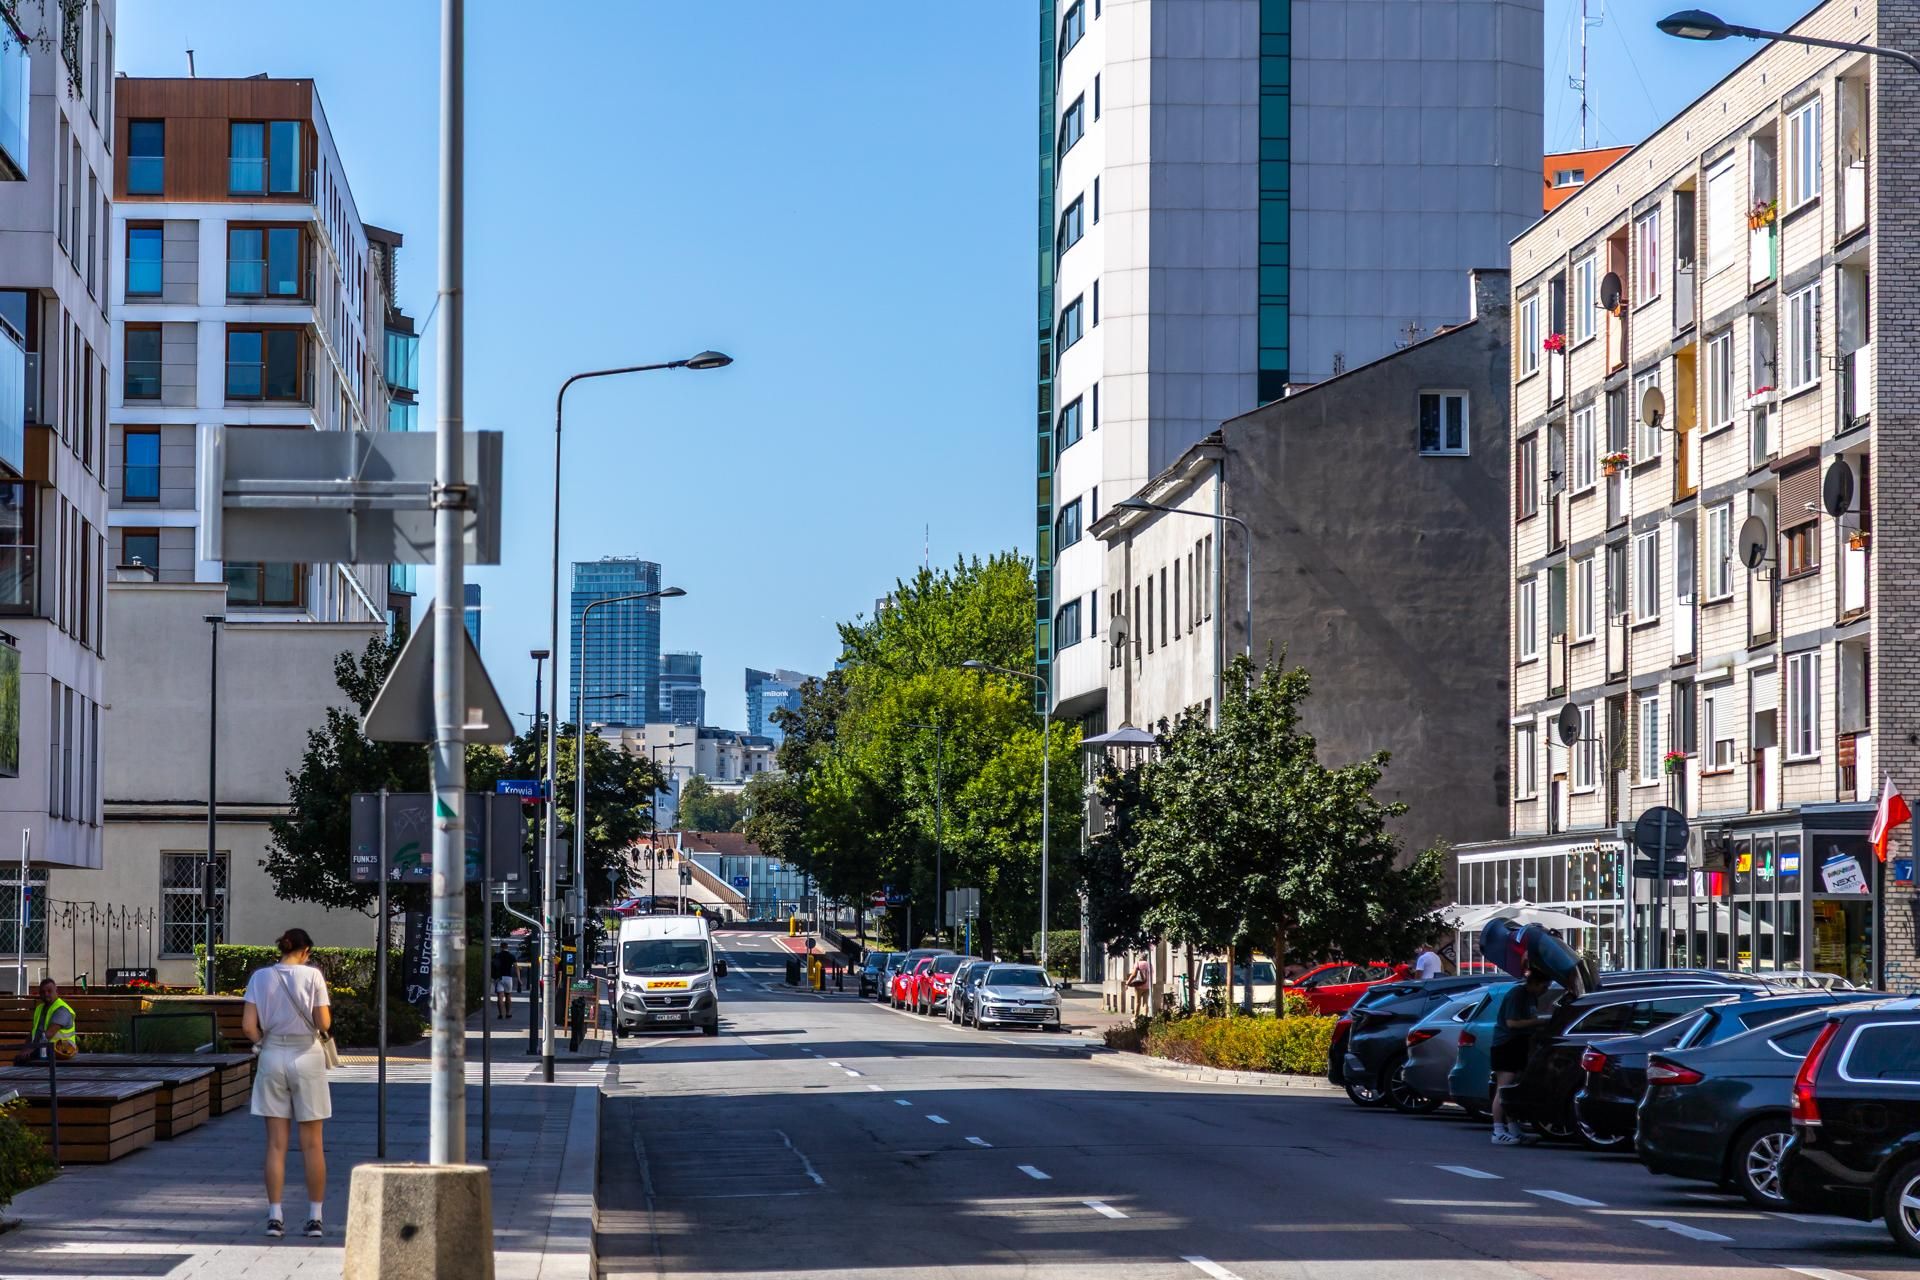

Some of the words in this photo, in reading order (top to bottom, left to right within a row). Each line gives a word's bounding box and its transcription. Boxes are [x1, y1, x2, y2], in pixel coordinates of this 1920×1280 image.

[764, 690, 789, 698] mBank
[504, 786, 533, 796] Krowia
[1832, 874, 1858, 889] NEXT
